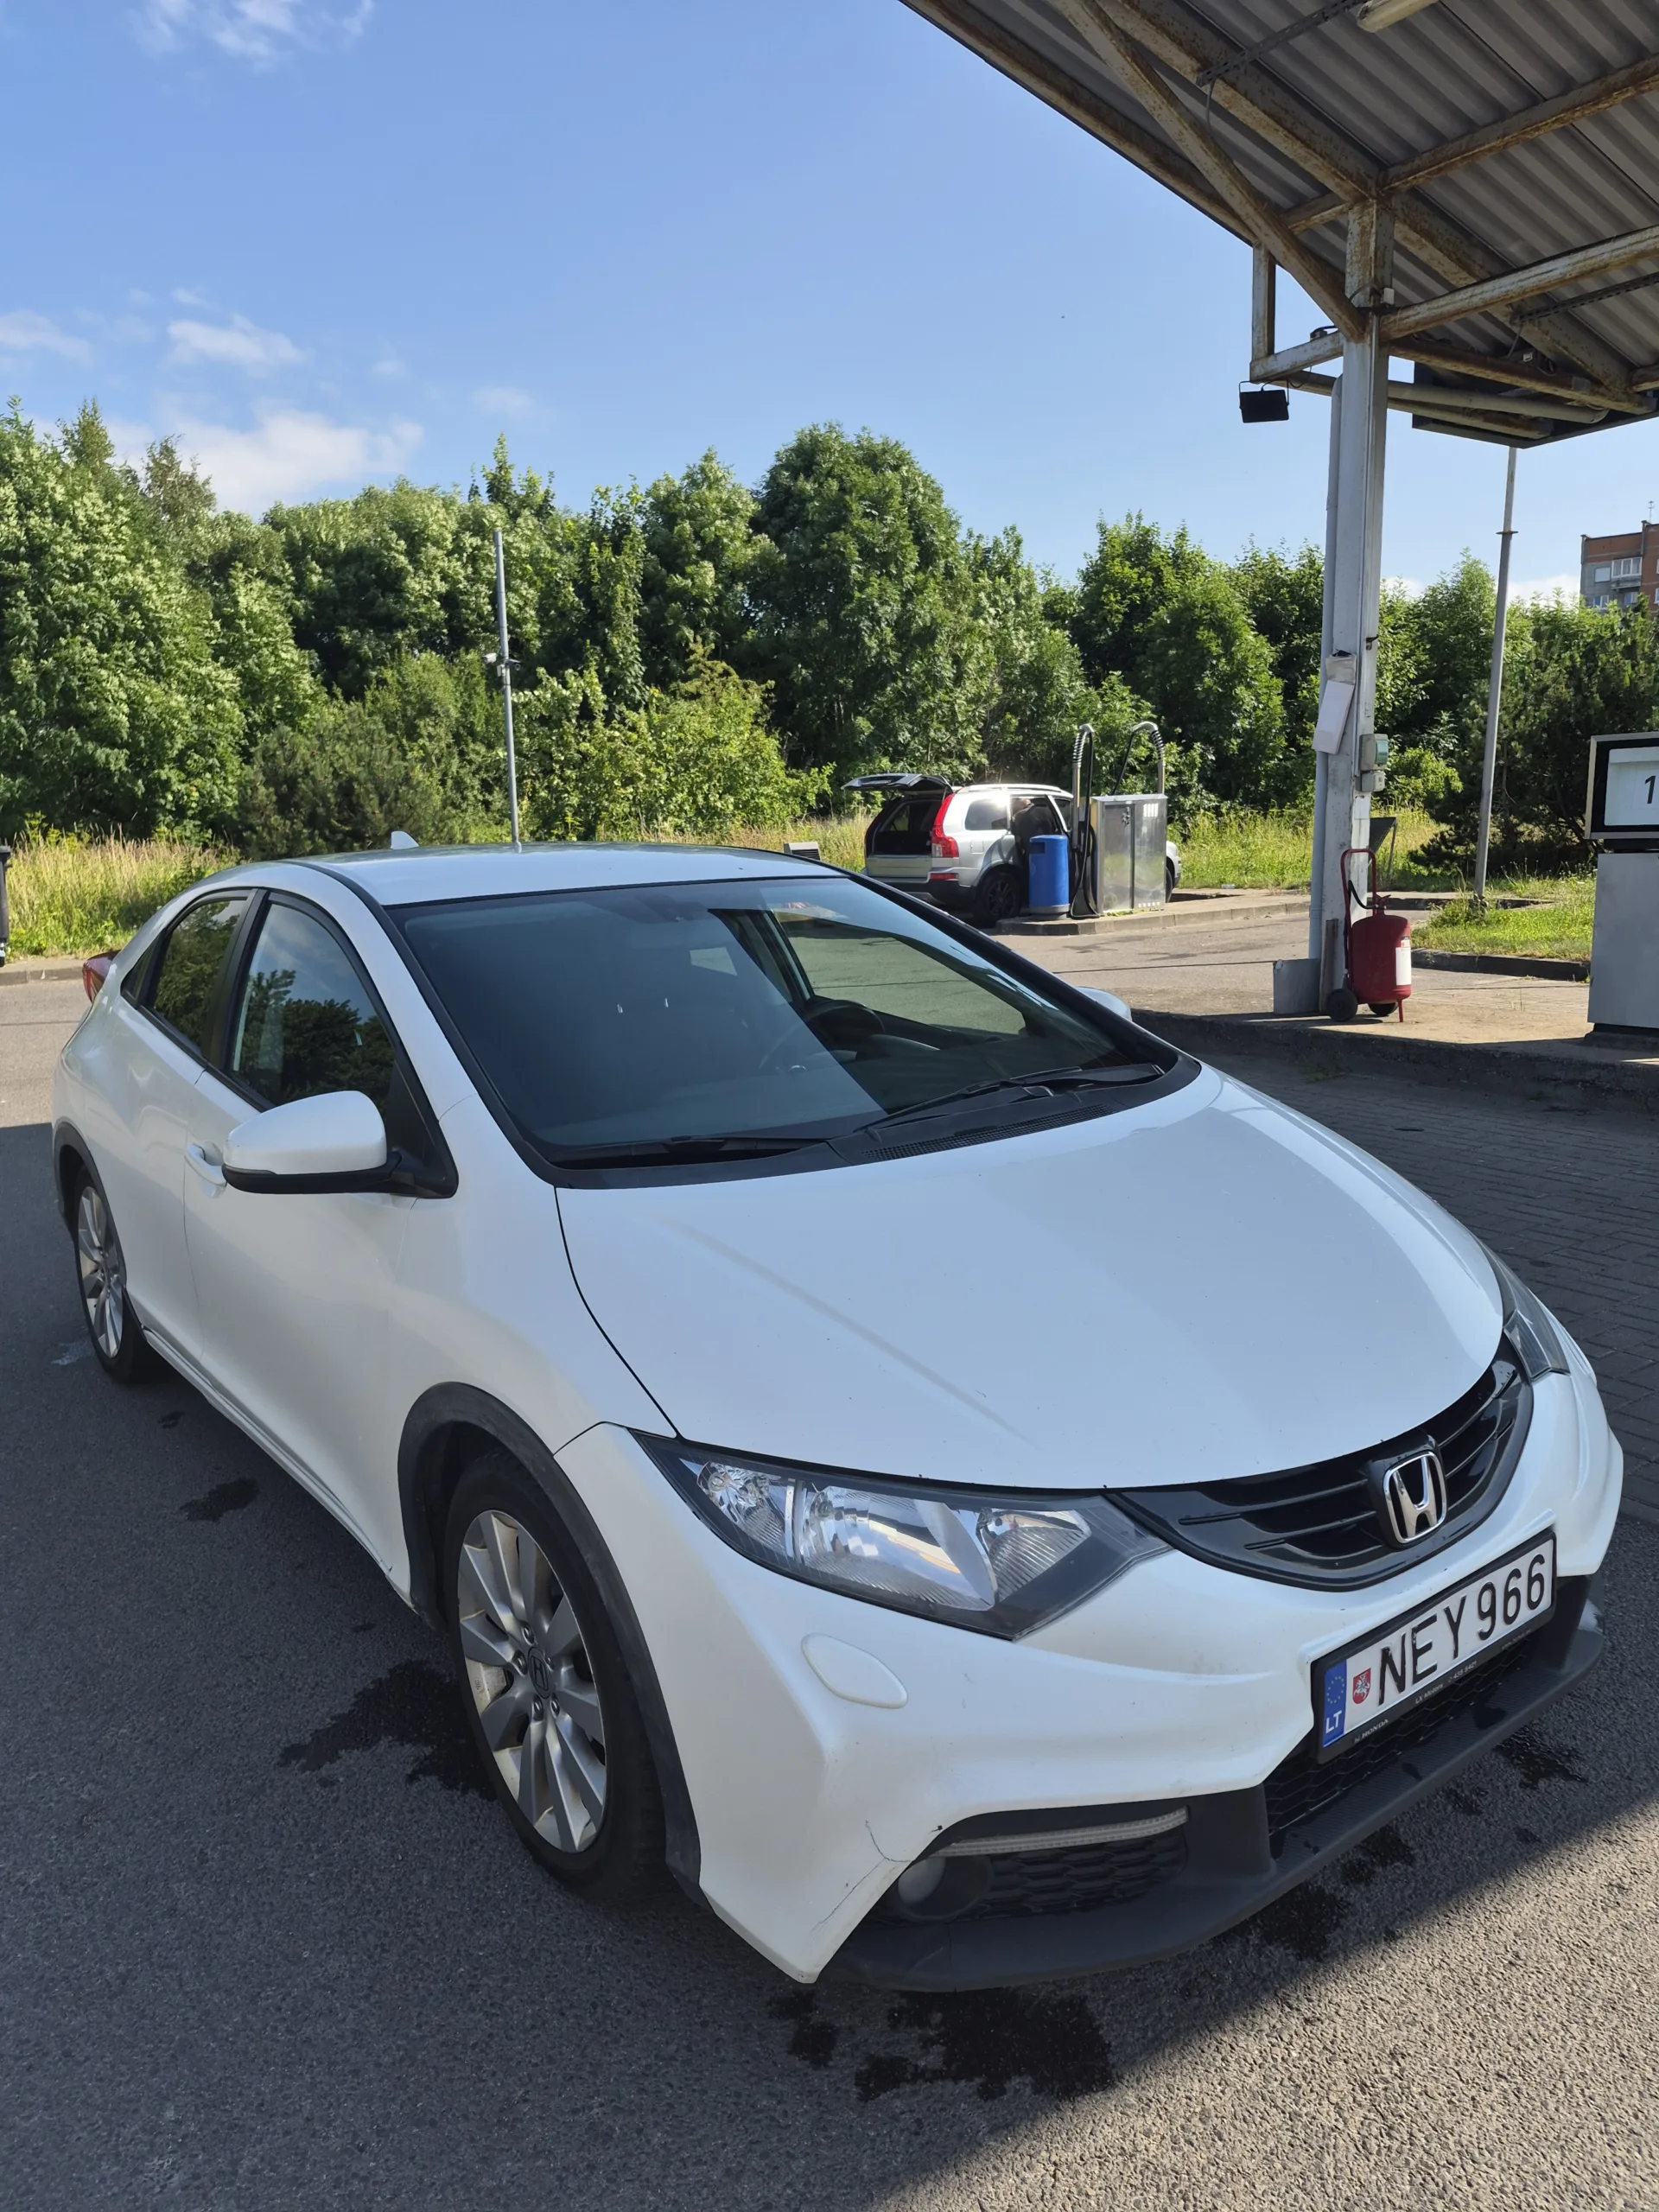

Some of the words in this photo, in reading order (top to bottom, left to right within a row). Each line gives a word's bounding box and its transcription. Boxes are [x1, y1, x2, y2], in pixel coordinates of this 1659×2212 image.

[1644, 775, 1656, 804] 1
[1389, 1453, 1441, 1541] H
[1325, 1710, 1343, 1733] LT
[1362, 1719, 1389, 1738] HONDA
